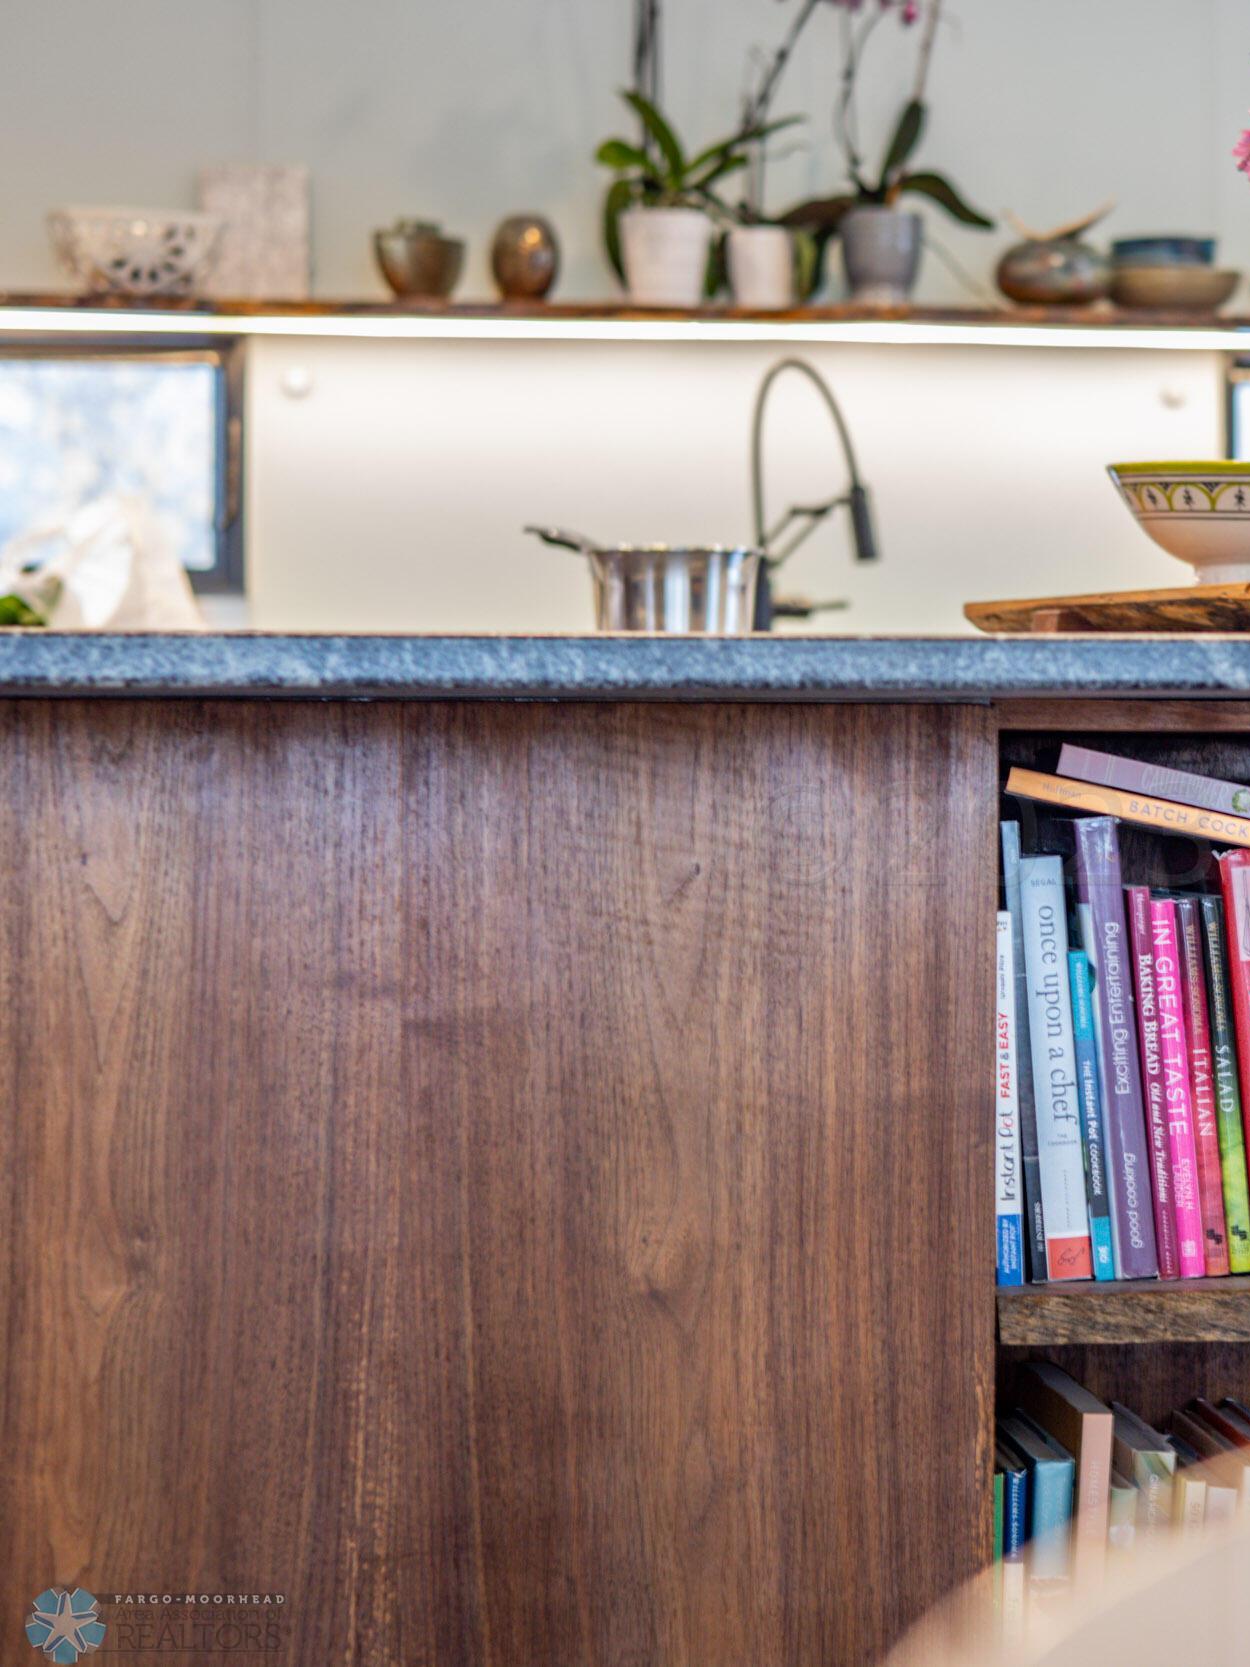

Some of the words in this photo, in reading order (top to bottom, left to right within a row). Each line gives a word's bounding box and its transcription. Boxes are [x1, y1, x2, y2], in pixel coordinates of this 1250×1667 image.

[1129, 800, 1188, 824] BATCH
[1038, 904, 1059, 964] once
[1153, 921, 1171, 946] IN
[1104, 922, 1126, 1025] Entertaining
[1138, 953, 1156, 1016] BAKING
[1156, 957, 1181, 1043] GREAT
[998, 1012, 1010, 1049] EASY
[1036, 973, 1064, 1038] upon
[1049, 1047, 1065, 1061] a
[1111, 1028, 1131, 1095] Exciting
[1143, 1021, 1161, 1075] BREAD
[1001, 1062, 1011, 1099] FAST
[1051, 1069, 1078, 1124] chef
[1084, 1080, 1097, 1119] Instant
[1150, 1082, 1162, 1102] Old
[1164, 1055, 1188, 1137] TASTE
[1192, 1048, 1214, 1137] ITALIAN
[1214, 1044, 1235, 1113] SALAD
[999, 1111, 1015, 1138] Pot
[1087, 1121, 1099, 1139] Pot
[1151, 1104, 1164, 1124] and
[1000, 1146, 1016, 1202] Instant
[1123, 1152, 1138, 1207] cooking
[1155, 1151, 1169, 1203] Traditions
[1128, 1210, 1144, 1250] good
